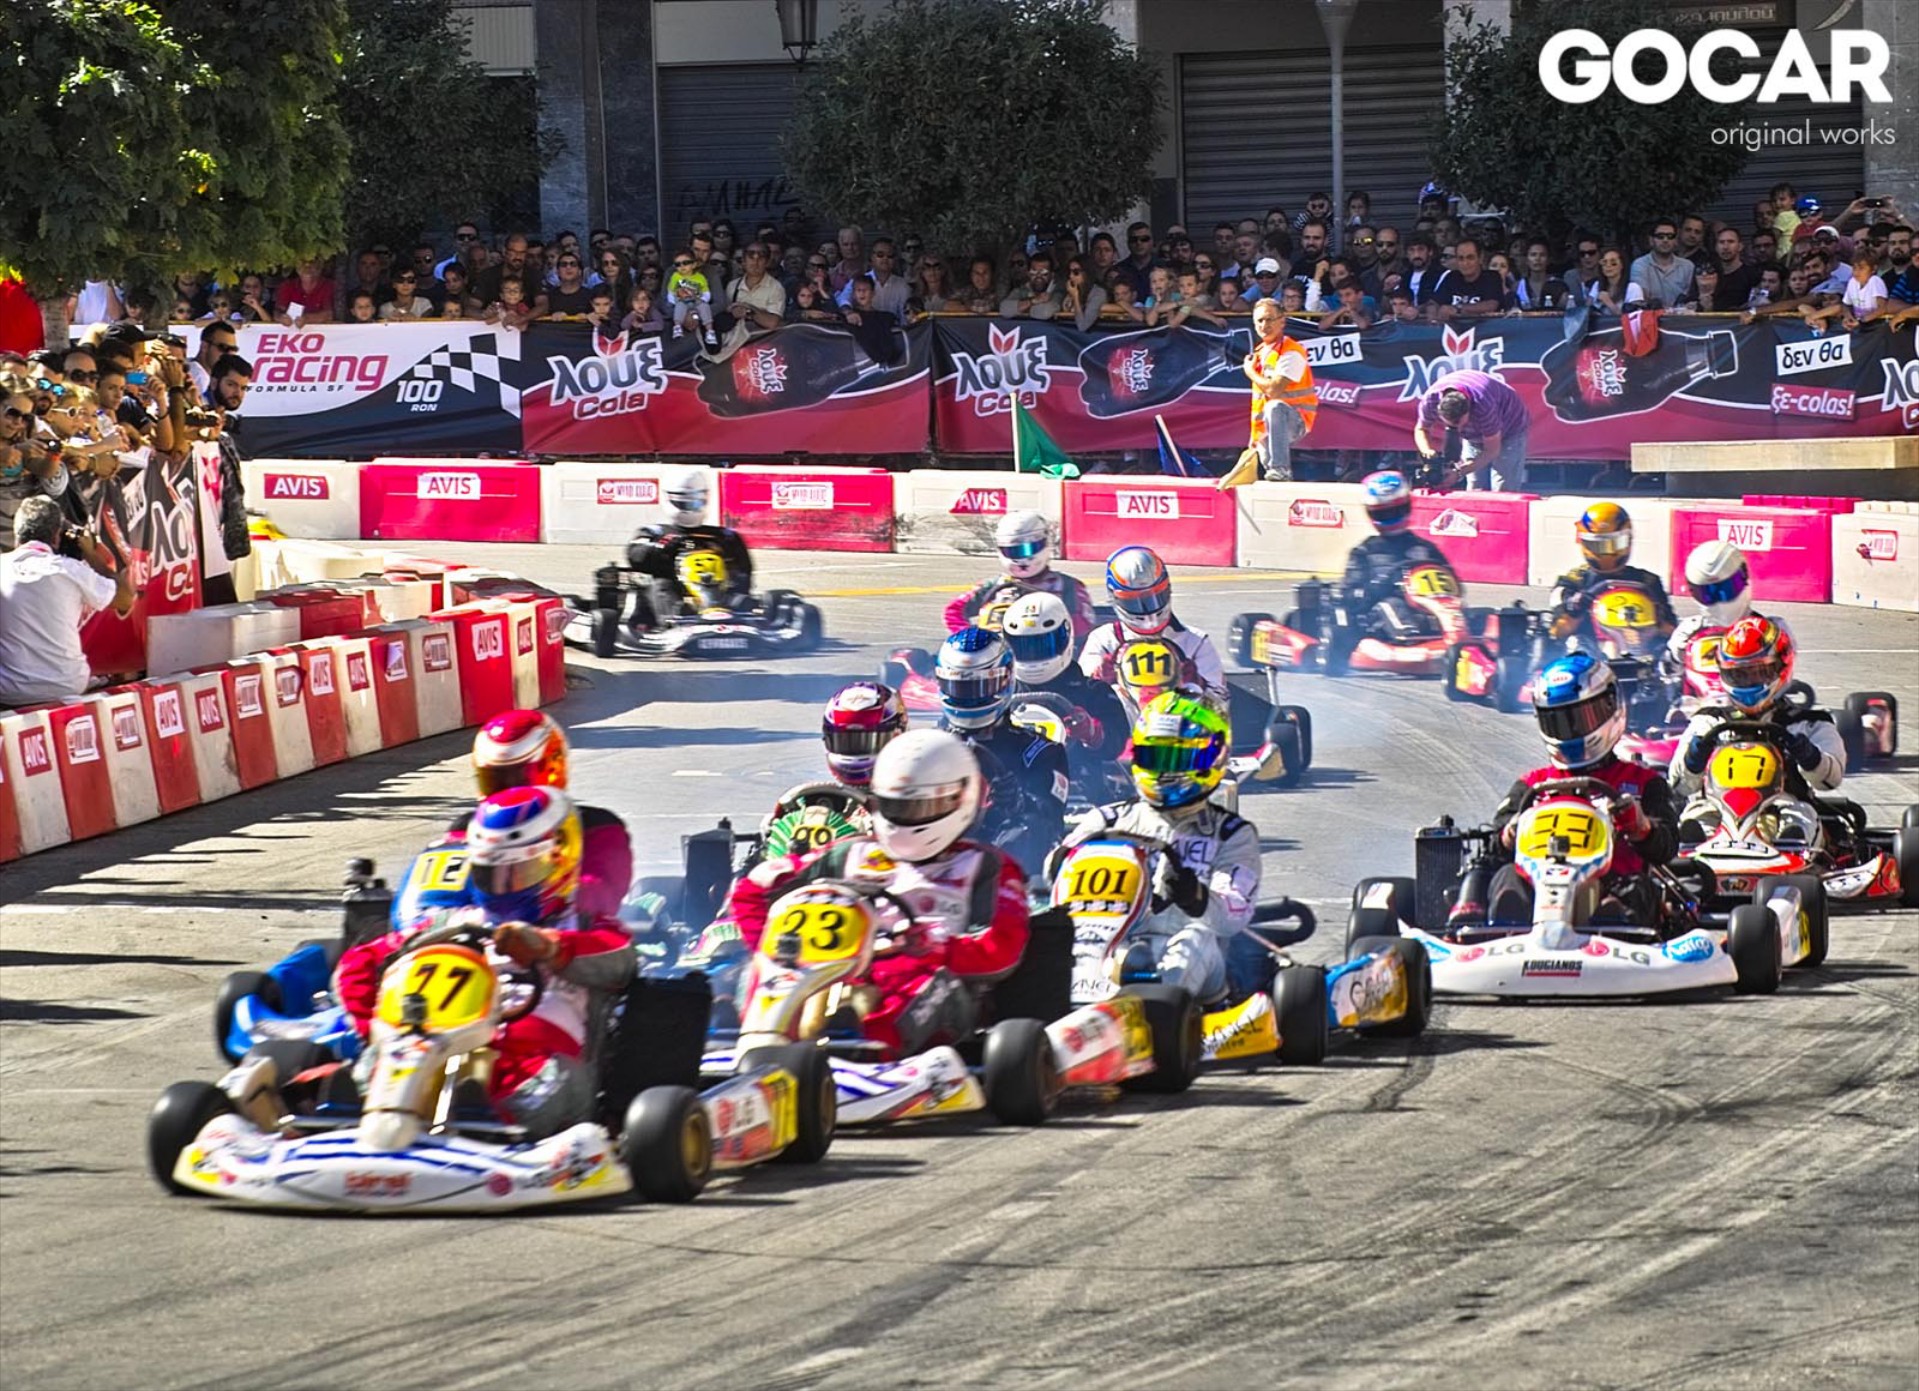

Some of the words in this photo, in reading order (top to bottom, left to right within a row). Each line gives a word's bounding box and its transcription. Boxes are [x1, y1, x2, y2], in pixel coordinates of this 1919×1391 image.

[257, 333, 325, 354] EKO
[1330, 337, 1354, 359] θα
[1782, 348, 1813, 370] δεν
[1820, 341, 1844, 361] θα
[251, 355, 389, 391] racing
[396, 379, 443, 403] 100
[575, 391, 648, 418] Cola
[975, 388, 1036, 415] Coa
[411, 403, 438, 412] RON
[273, 477, 322, 496] AVIS
[427, 477, 471, 494] AVIS
[957, 491, 1000, 510] AVIS
[1127, 495, 1170, 514] AVIS
[1727, 524, 1764, 545] AVIS
[477, 626, 499, 655] AVIS
[1126, 651, 1171, 677] 111
[160, 698, 178, 730] AVIS
[200, 694, 220, 727] AVIS
[24, 733, 48, 769] AVIS
[1728, 755, 1766, 782] 17
[421, 856, 467, 883] 12
[1070, 867, 1129, 897] 101
[784, 909, 844, 950] 23
[1488, 944, 1525, 957] LG
[1612, 949, 1650, 966] LG
[414, 963, 475, 1012] 77
